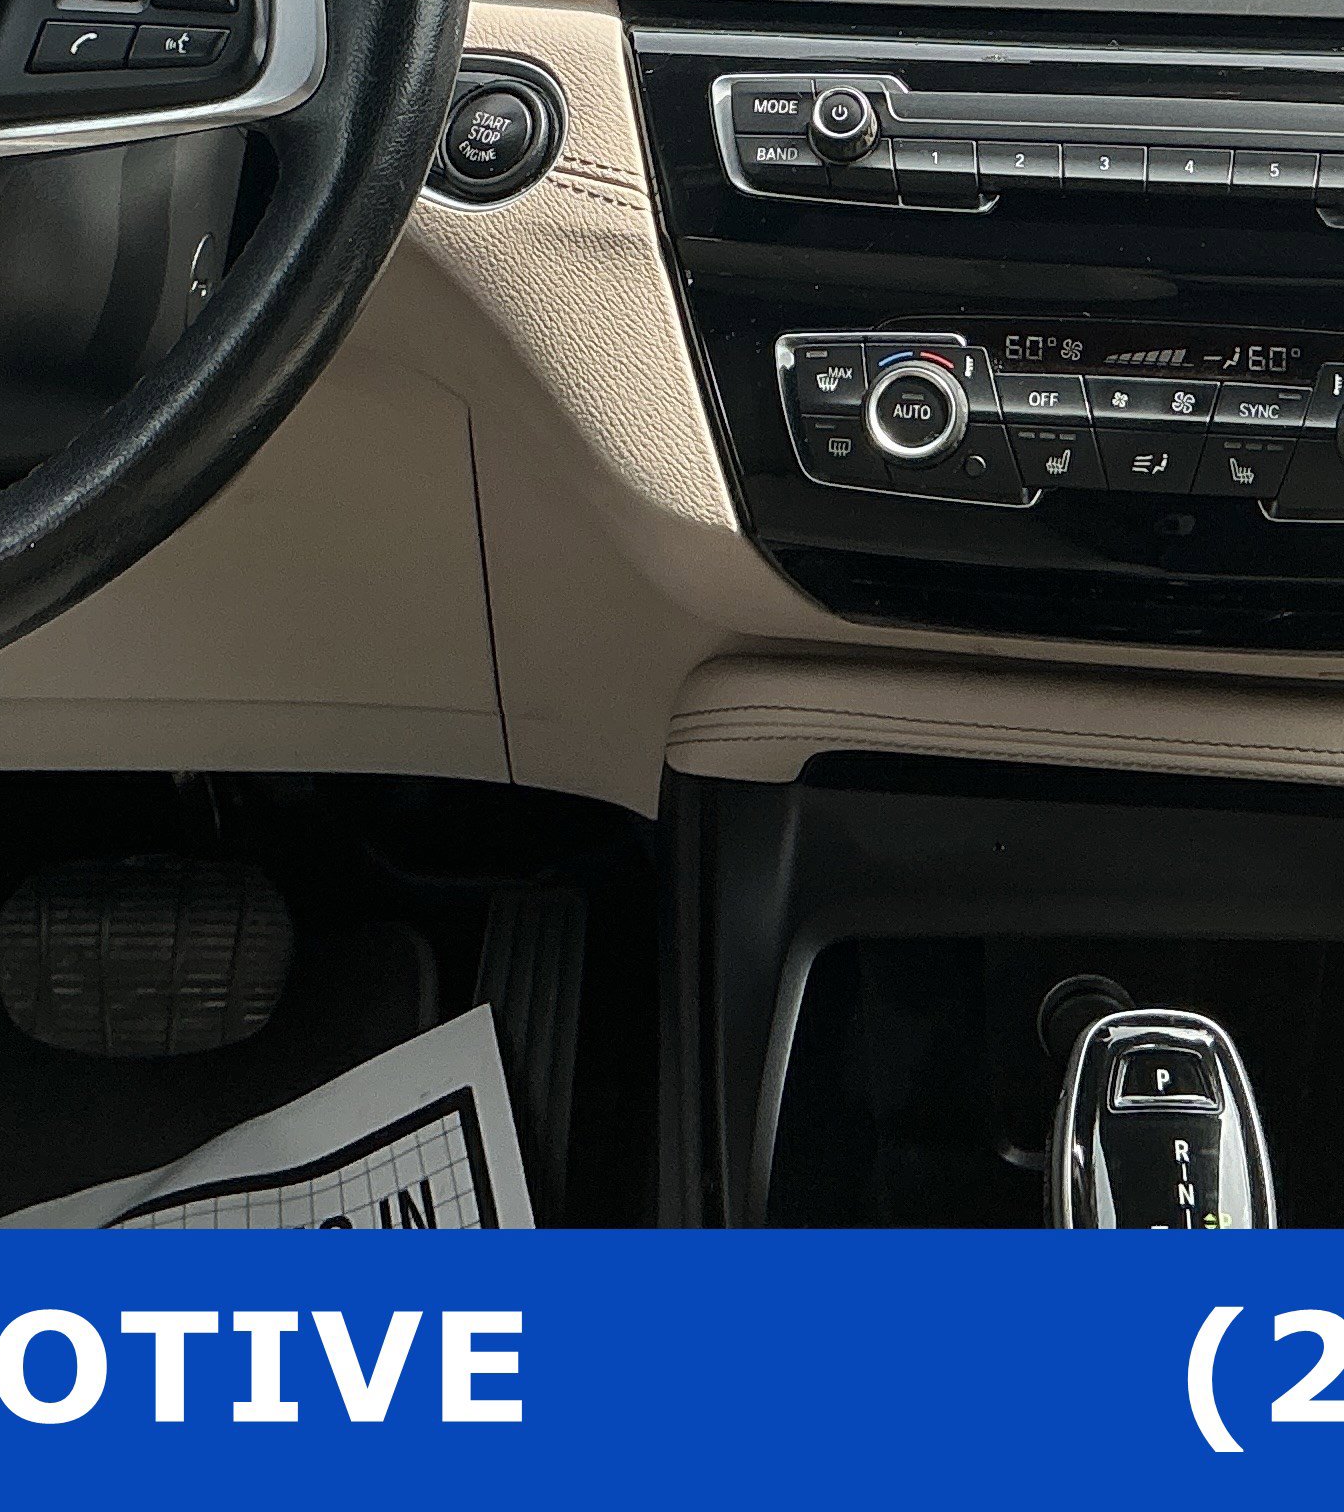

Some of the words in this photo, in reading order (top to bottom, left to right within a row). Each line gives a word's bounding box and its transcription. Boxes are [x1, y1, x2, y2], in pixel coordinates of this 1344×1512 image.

[753, 98, 799, 115] MODE
[472, 111, 512, 132] START
[467, 125, 501, 145] STOP
[458, 140, 497, 163] ENGINE
[755, 146, 799, 163] BAND
[931, 152, 939, 166] 1
[1014, 154, 1025, 169] 2
[1099, 157, 1110, 172] 3
[1184, 159, 1195, 175] 4
[1269, 162, 1280, 178] 5
[828, 366, 853, 379] MAX
[1028, 391, 1059, 407] OFF
[892, 403, 932, 420] AUTO
[1239, 403, 1280, 419] SYNC
[1156, 1068, 1170, 1092] P
[1174, 1139, 1190, 1163] R
[1178, 1183, 1195, 1206] N
